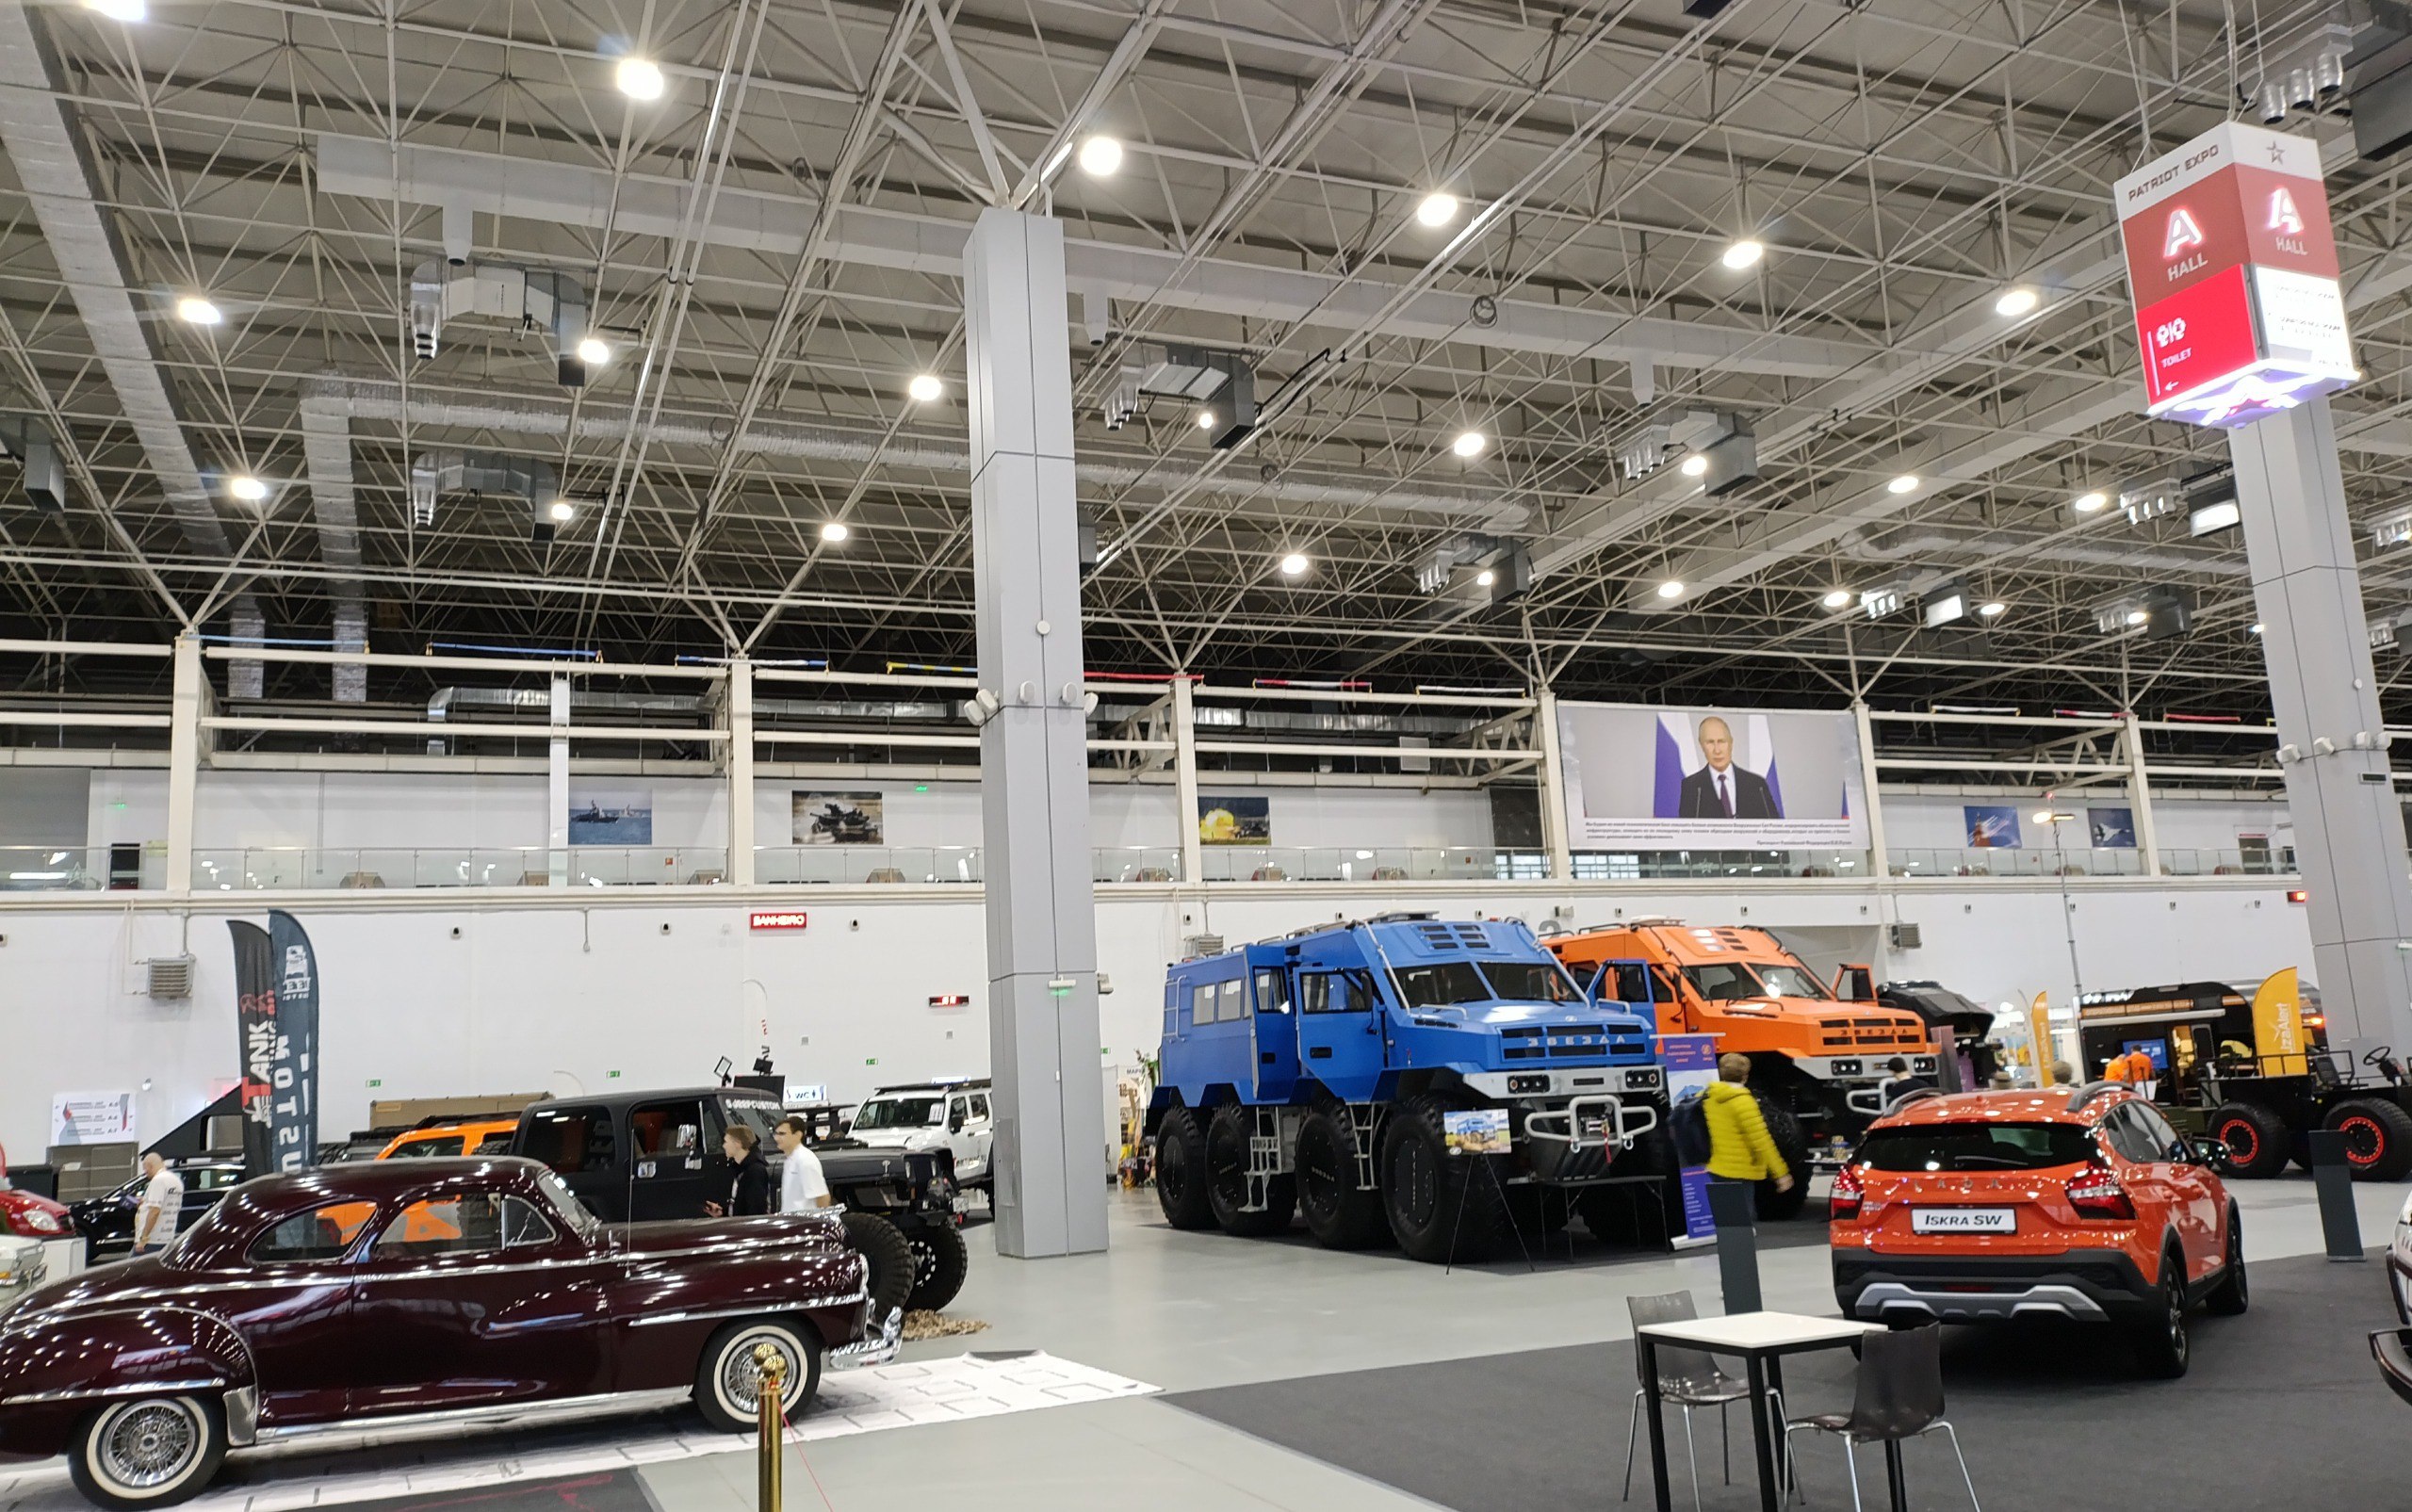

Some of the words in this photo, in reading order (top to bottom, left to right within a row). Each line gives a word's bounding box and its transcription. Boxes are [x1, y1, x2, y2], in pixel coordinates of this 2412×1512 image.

[2128, 168, 2179, 202] PATRIOT
[2185, 144, 2220, 171] EXPO
[2266, 187, 2305, 234] A
[2163, 207, 2204, 257] A
[2275, 236, 2307, 256] HALL
[2168, 252, 2208, 283] HALL
[2161, 348, 2192, 368] TOILET
[1528, 1035, 1625, 1047] ЗВЕЗДА
[241, 1020, 271, 1108] TANK
[1915, 1178, 1999, 1192] LADA
[1925, 1214, 1969, 1226] ISKRA
[1973, 1214, 2002, 1226] SW
